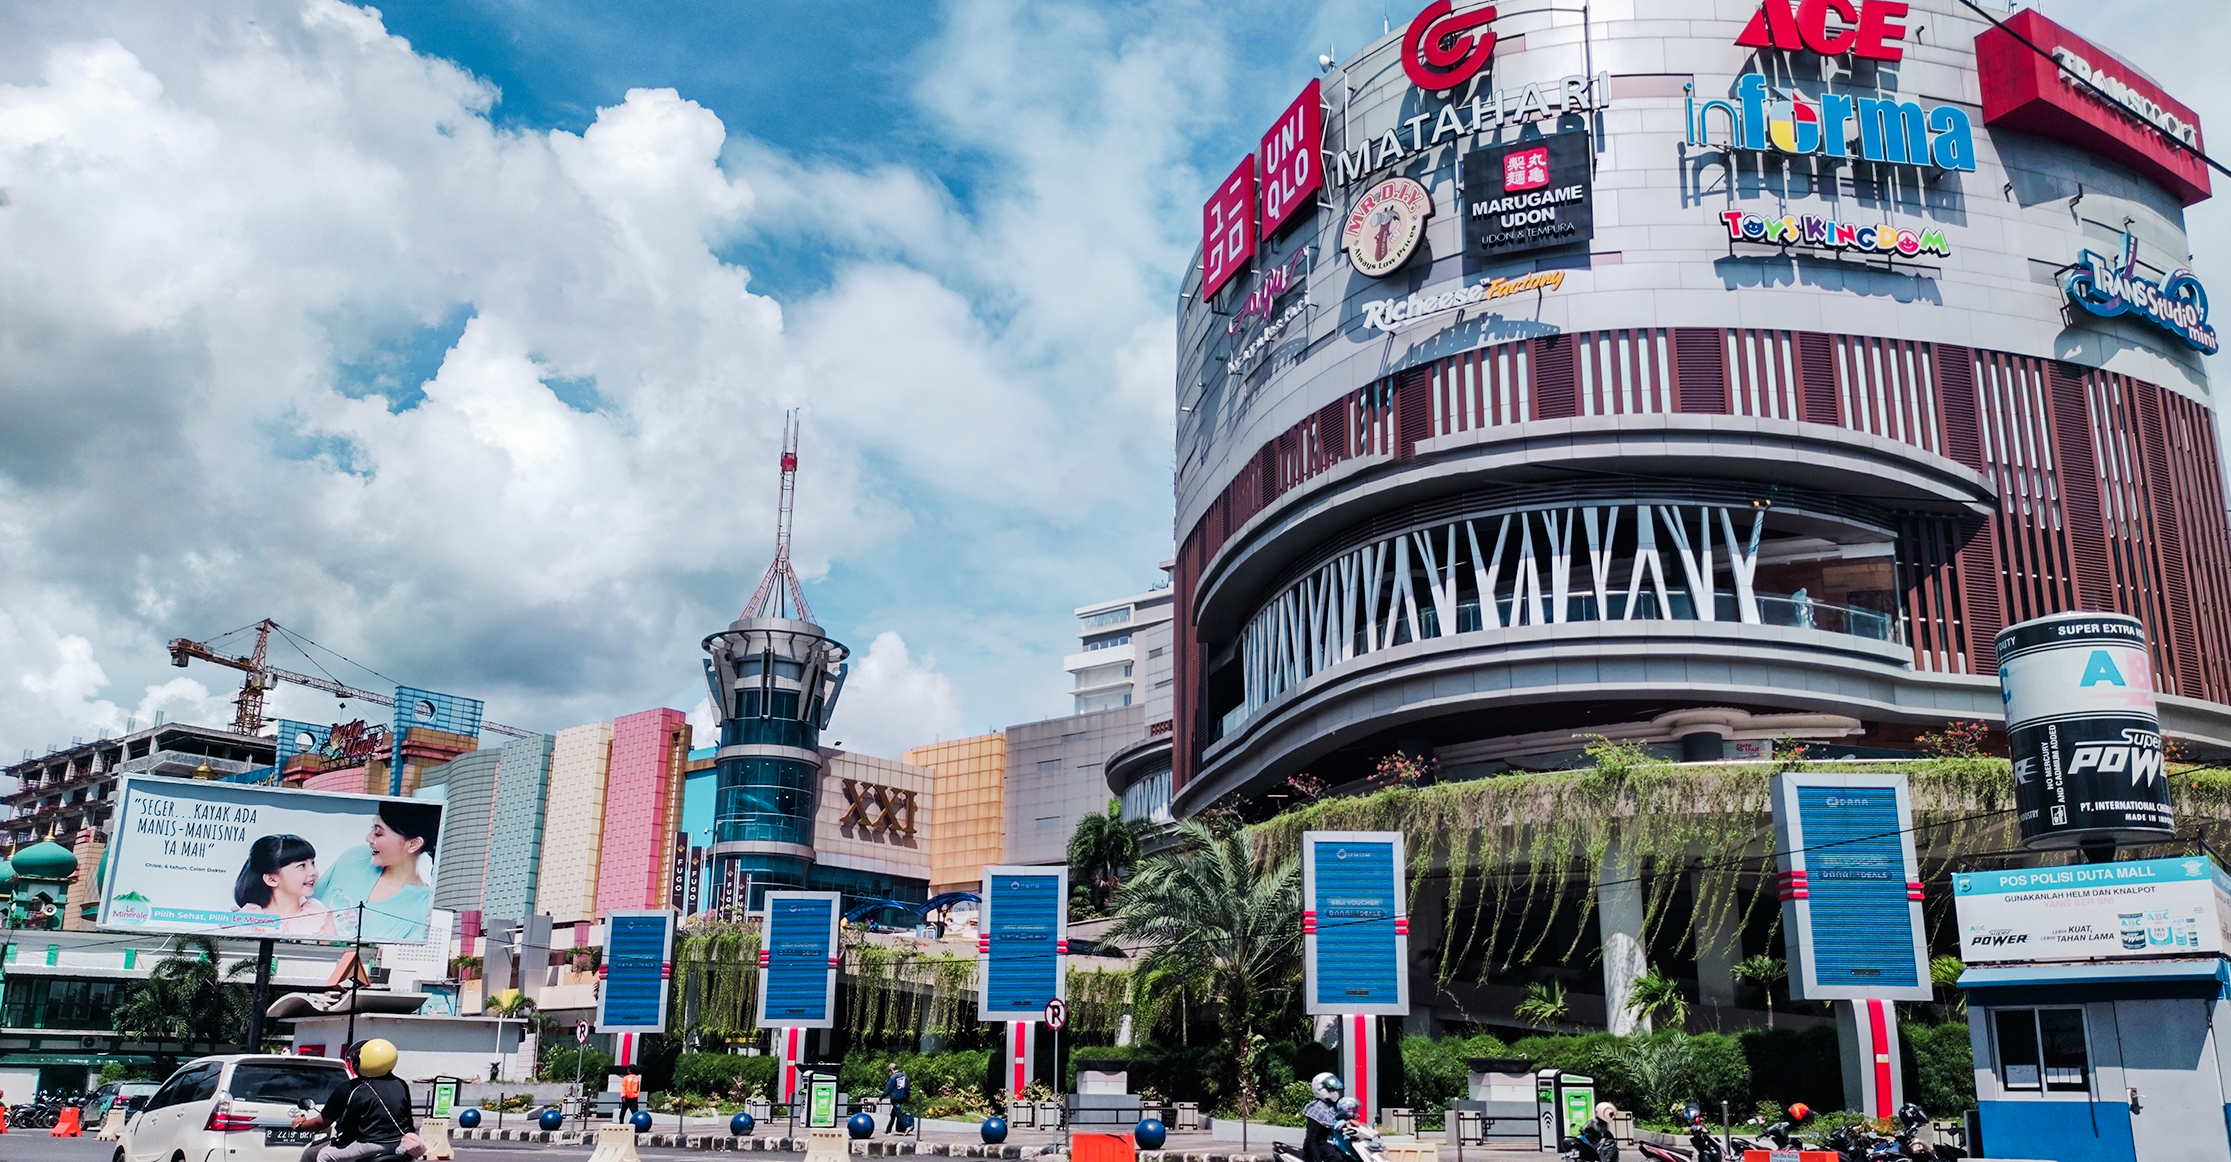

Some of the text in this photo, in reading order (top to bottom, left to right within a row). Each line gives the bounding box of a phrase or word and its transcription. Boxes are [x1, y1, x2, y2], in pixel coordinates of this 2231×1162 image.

[1733, 0, 1909, 61] ACE
[1336, 70, 1610, 187] MATAHARI
[1683, 73, 1977, 172] informa
[1267, 104, 1304, 174] UNI
[1267, 148, 1309, 220] QLO
[1472, 184, 1583, 216] MARUGAME
[1501, 207, 1555, 228] UDON
[1481, 222, 1575, 244] UDON & TEMPURA
[1721, 210, 1950, 258] TOYS KINGDOM
[1354, 247, 1376, 271] Always
[1378, 257, 1396, 270] Low
[1396, 224, 1417, 258] Prices
[1361, 283, 1485, 332] Richeese
[1487, 269, 1565, 300] Factory
[2188, 326, 2217, 350] mini
[2058, 624, 2100, 636] SUPER
[2103, 624, 2135, 637] EXTRA
[2040, 741, 2055, 790] NO MERCURY
[2048, 724, 2066, 803] AND CADMIUM ADDED
[233, 808, 257, 824] ADA
[839, 778, 918, 834] XXI
[2080, 802, 2094, 812] PT.
[2095, 800, 2156, 812] INTERNATIONAL
[2125, 813, 2147, 822] MADE
[2148, 814, 2156, 822] IN
[137, 818, 246, 842] MANIS-MANISNYA
[164, 840, 176, 855] YA
[675, 858, 684, 892] FUGO
[689, 870, 698, 901] FUGO
[1999, 866, 2156, 888] POS POLISI DUTA MALL
[725, 882, 733, 909] FUGO
[2004, 886, 2156, 903] GUNAKANLAH HELM DAN KNALPOT
[2043, 897, 2114, 909] YANG BER SNI
[112, 910, 148, 919] Minerale
[153, 910, 175, 919] Pilih
[177, 911, 206, 921] Sehat,
[208, 914, 229, 922] Pilih
[736, 894, 744, 921] FUO
[2147, 911, 2169, 922] ABC
[1971, 934, 2030, 948] POWER
[2056, 934, 2087, 943] TAHAN
[2088, 932, 2115, 942] LAMA
[2068, 925, 2093, 934] KUAT,
